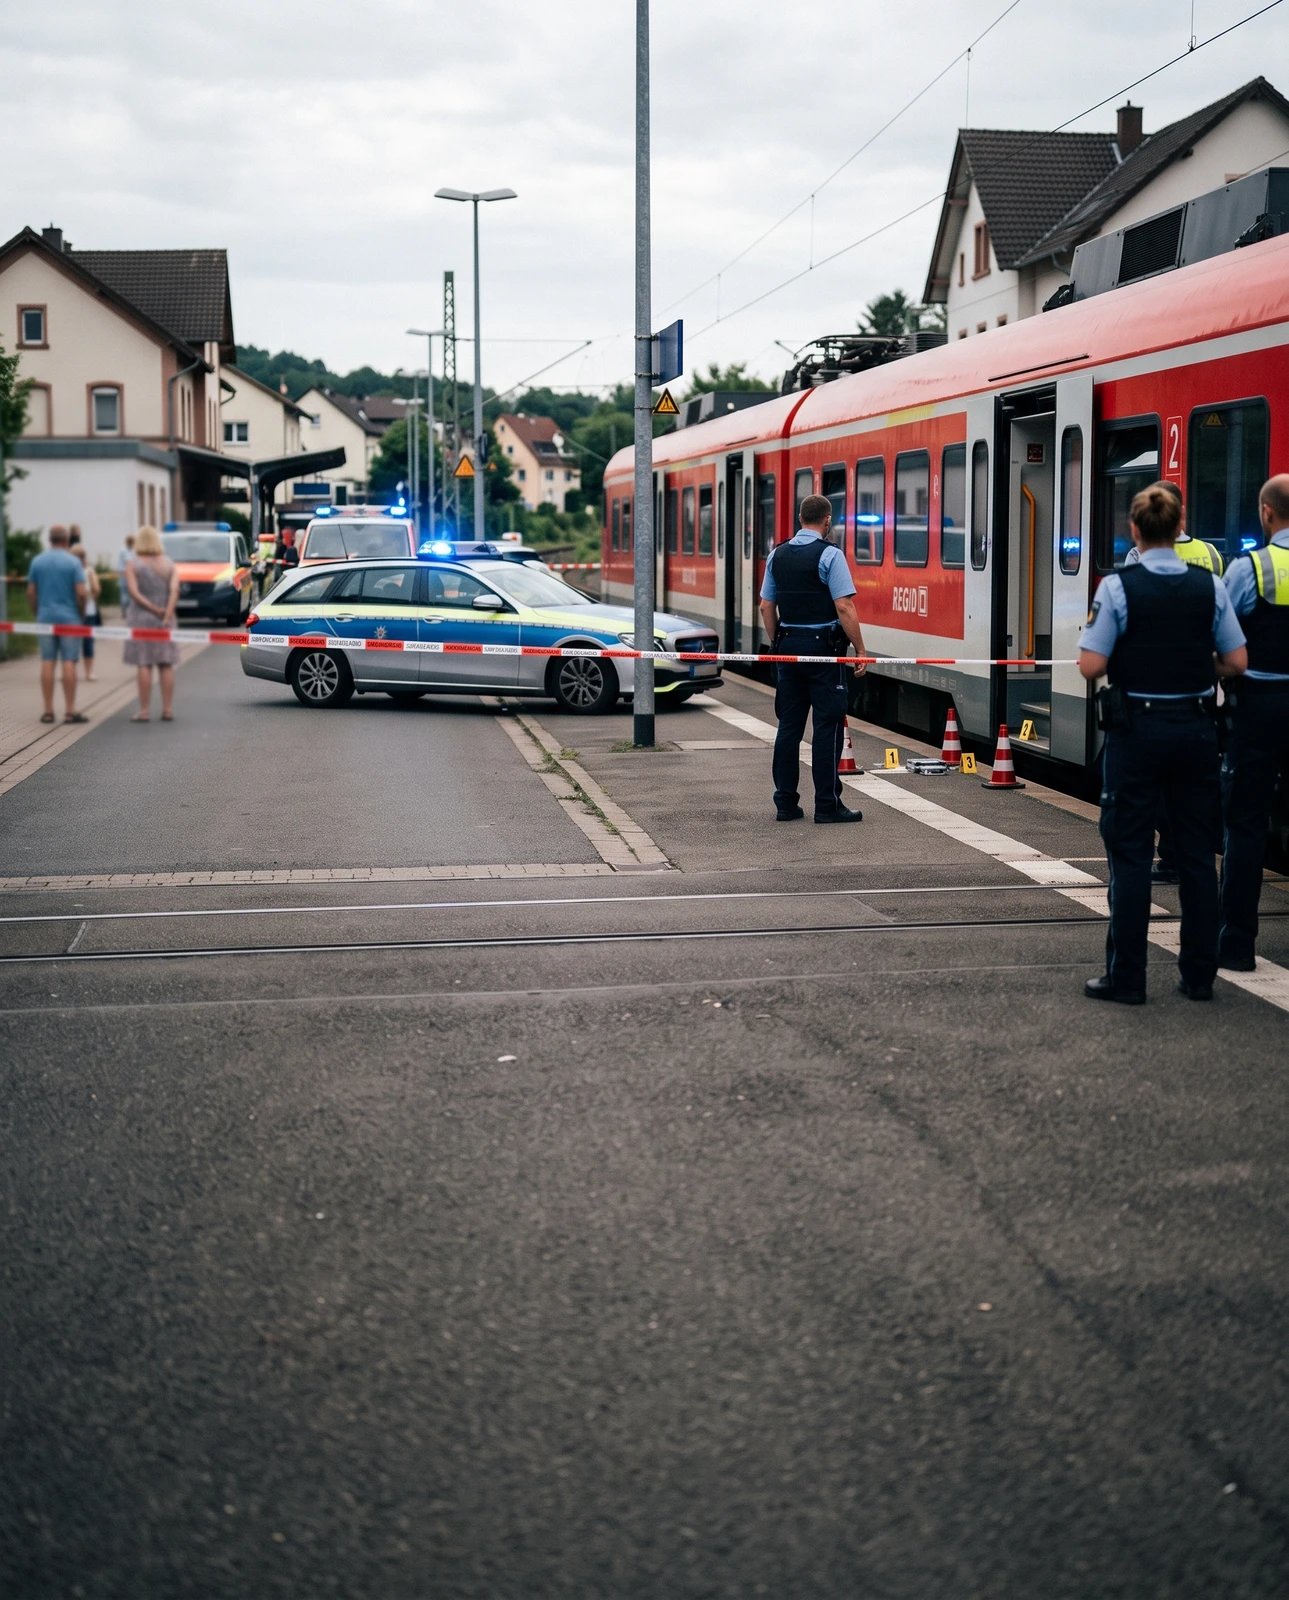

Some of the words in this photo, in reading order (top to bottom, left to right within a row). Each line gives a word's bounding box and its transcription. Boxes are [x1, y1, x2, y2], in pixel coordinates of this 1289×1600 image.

[1169, 423, 1179, 469] 2
[1022, 723, 1029, 737] 2
[889, 751, 895, 764] 1
[966, 756, 973, 769] 3
